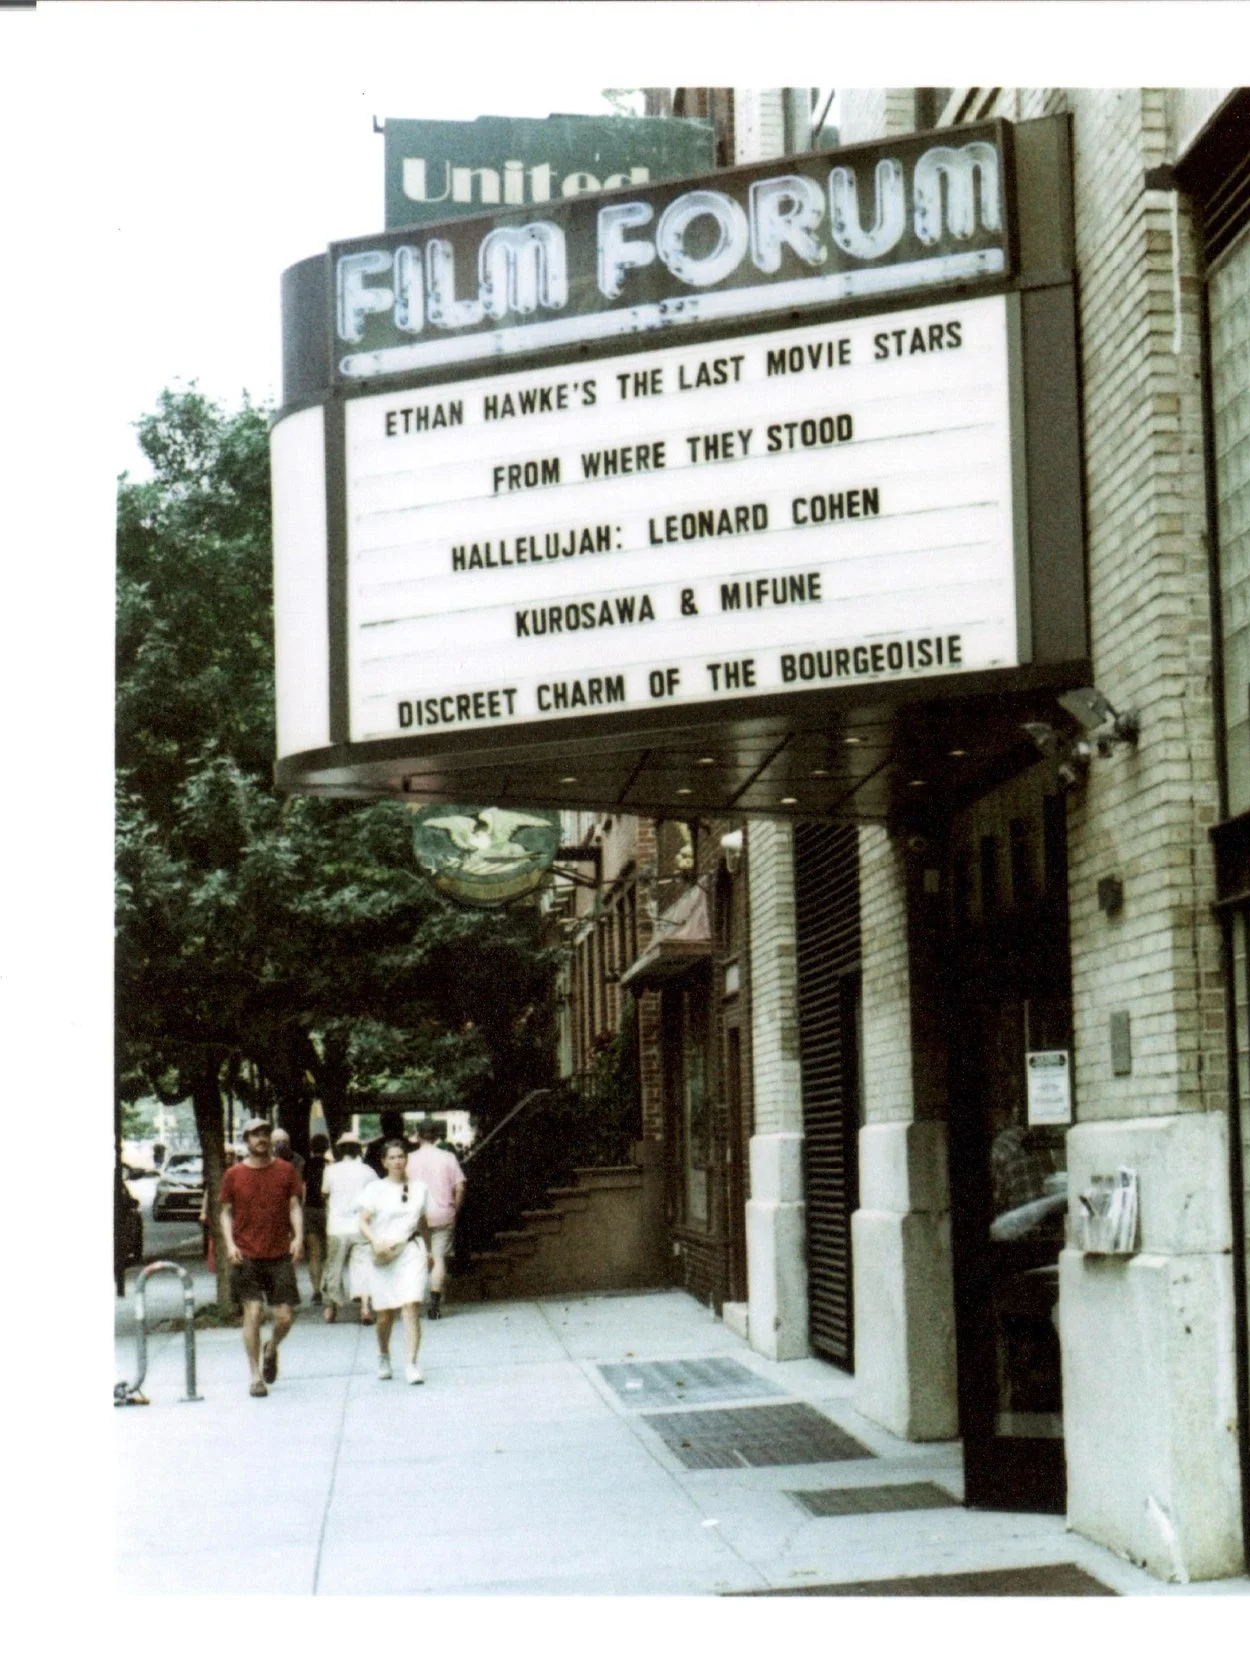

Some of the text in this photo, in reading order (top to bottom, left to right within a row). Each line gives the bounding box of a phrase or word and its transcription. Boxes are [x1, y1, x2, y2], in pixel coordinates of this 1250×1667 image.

[336, 140, 1001, 343] FILM FORUM
[384, 320, 963, 439] ETHAN HAWKE'S THE LAST MOVIE STARS
[492, 413, 854, 493] FROM WHERE THEY STOOD
[451, 486, 880, 573] HALLELUJAH: LEONARD COHEN
[514, 571, 822, 638] KUROSAWA & MIFUNE
[397, 634, 964, 729] DISCREET CHARM OF THE BOURGEOISIE
